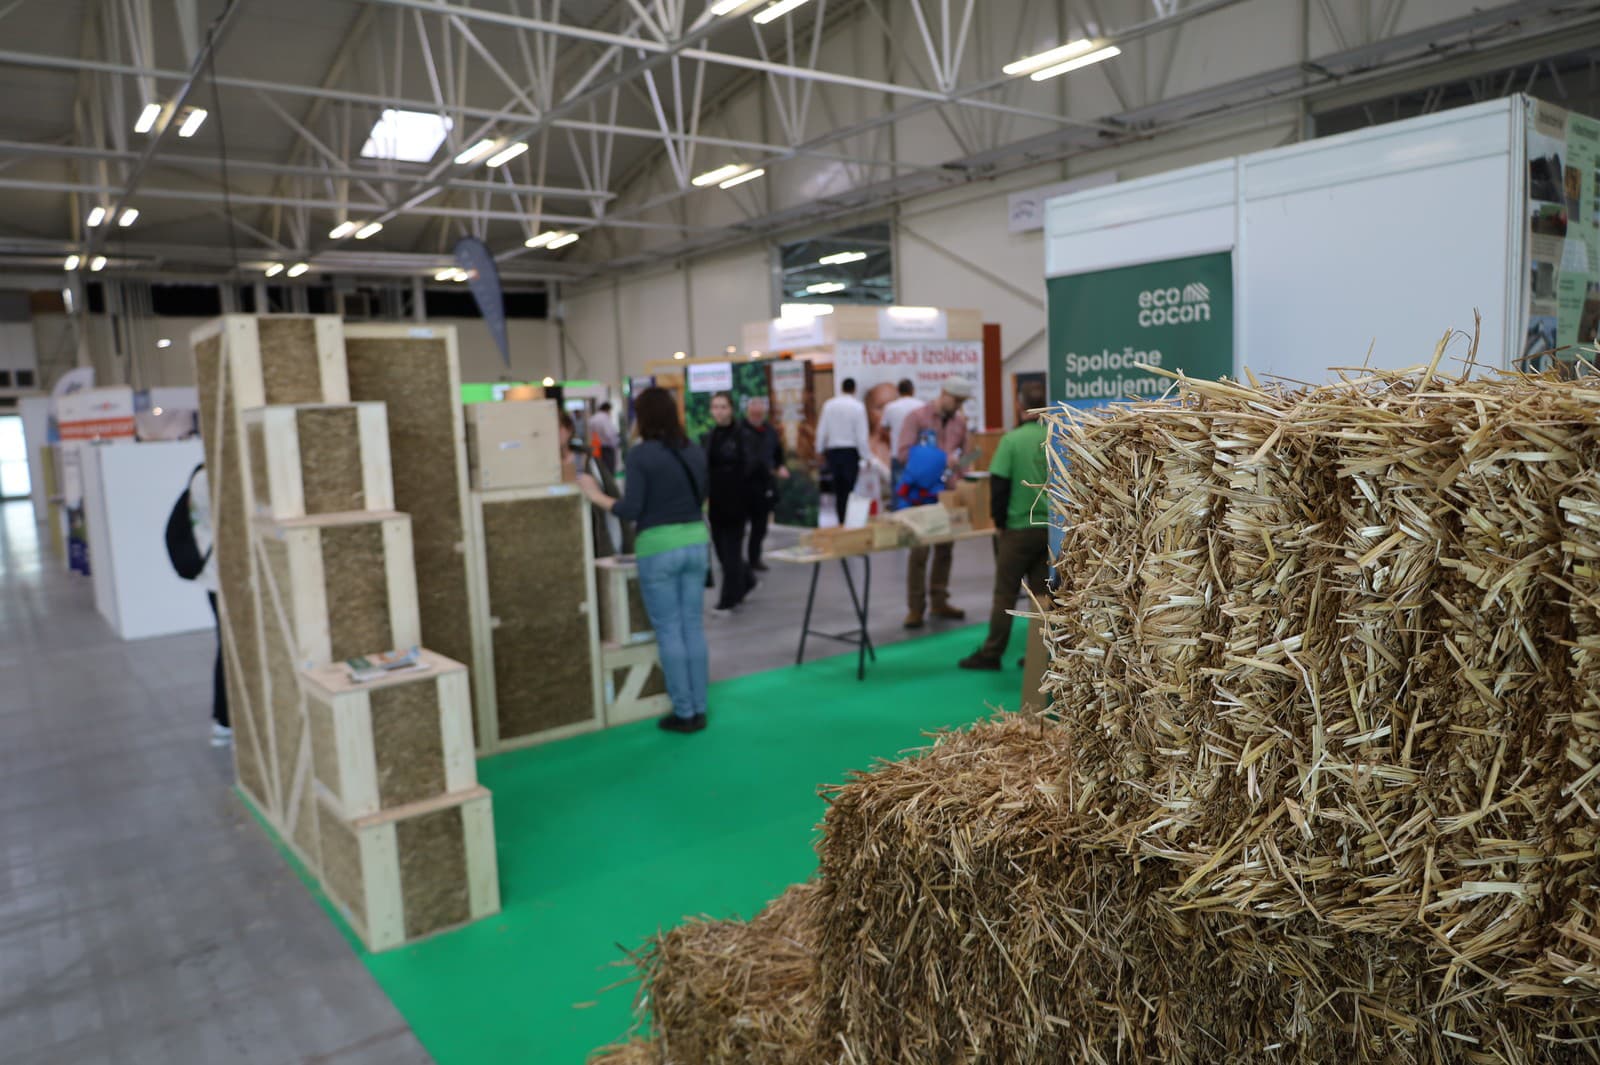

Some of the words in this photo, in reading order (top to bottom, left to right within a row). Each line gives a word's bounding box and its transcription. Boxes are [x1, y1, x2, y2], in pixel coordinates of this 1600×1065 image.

[1138, 287, 1181, 308] eco
[1138, 303, 1211, 327] cocon
[1065, 347, 1162, 376] Spoločne
[1065, 375, 1171, 399] budujeme
